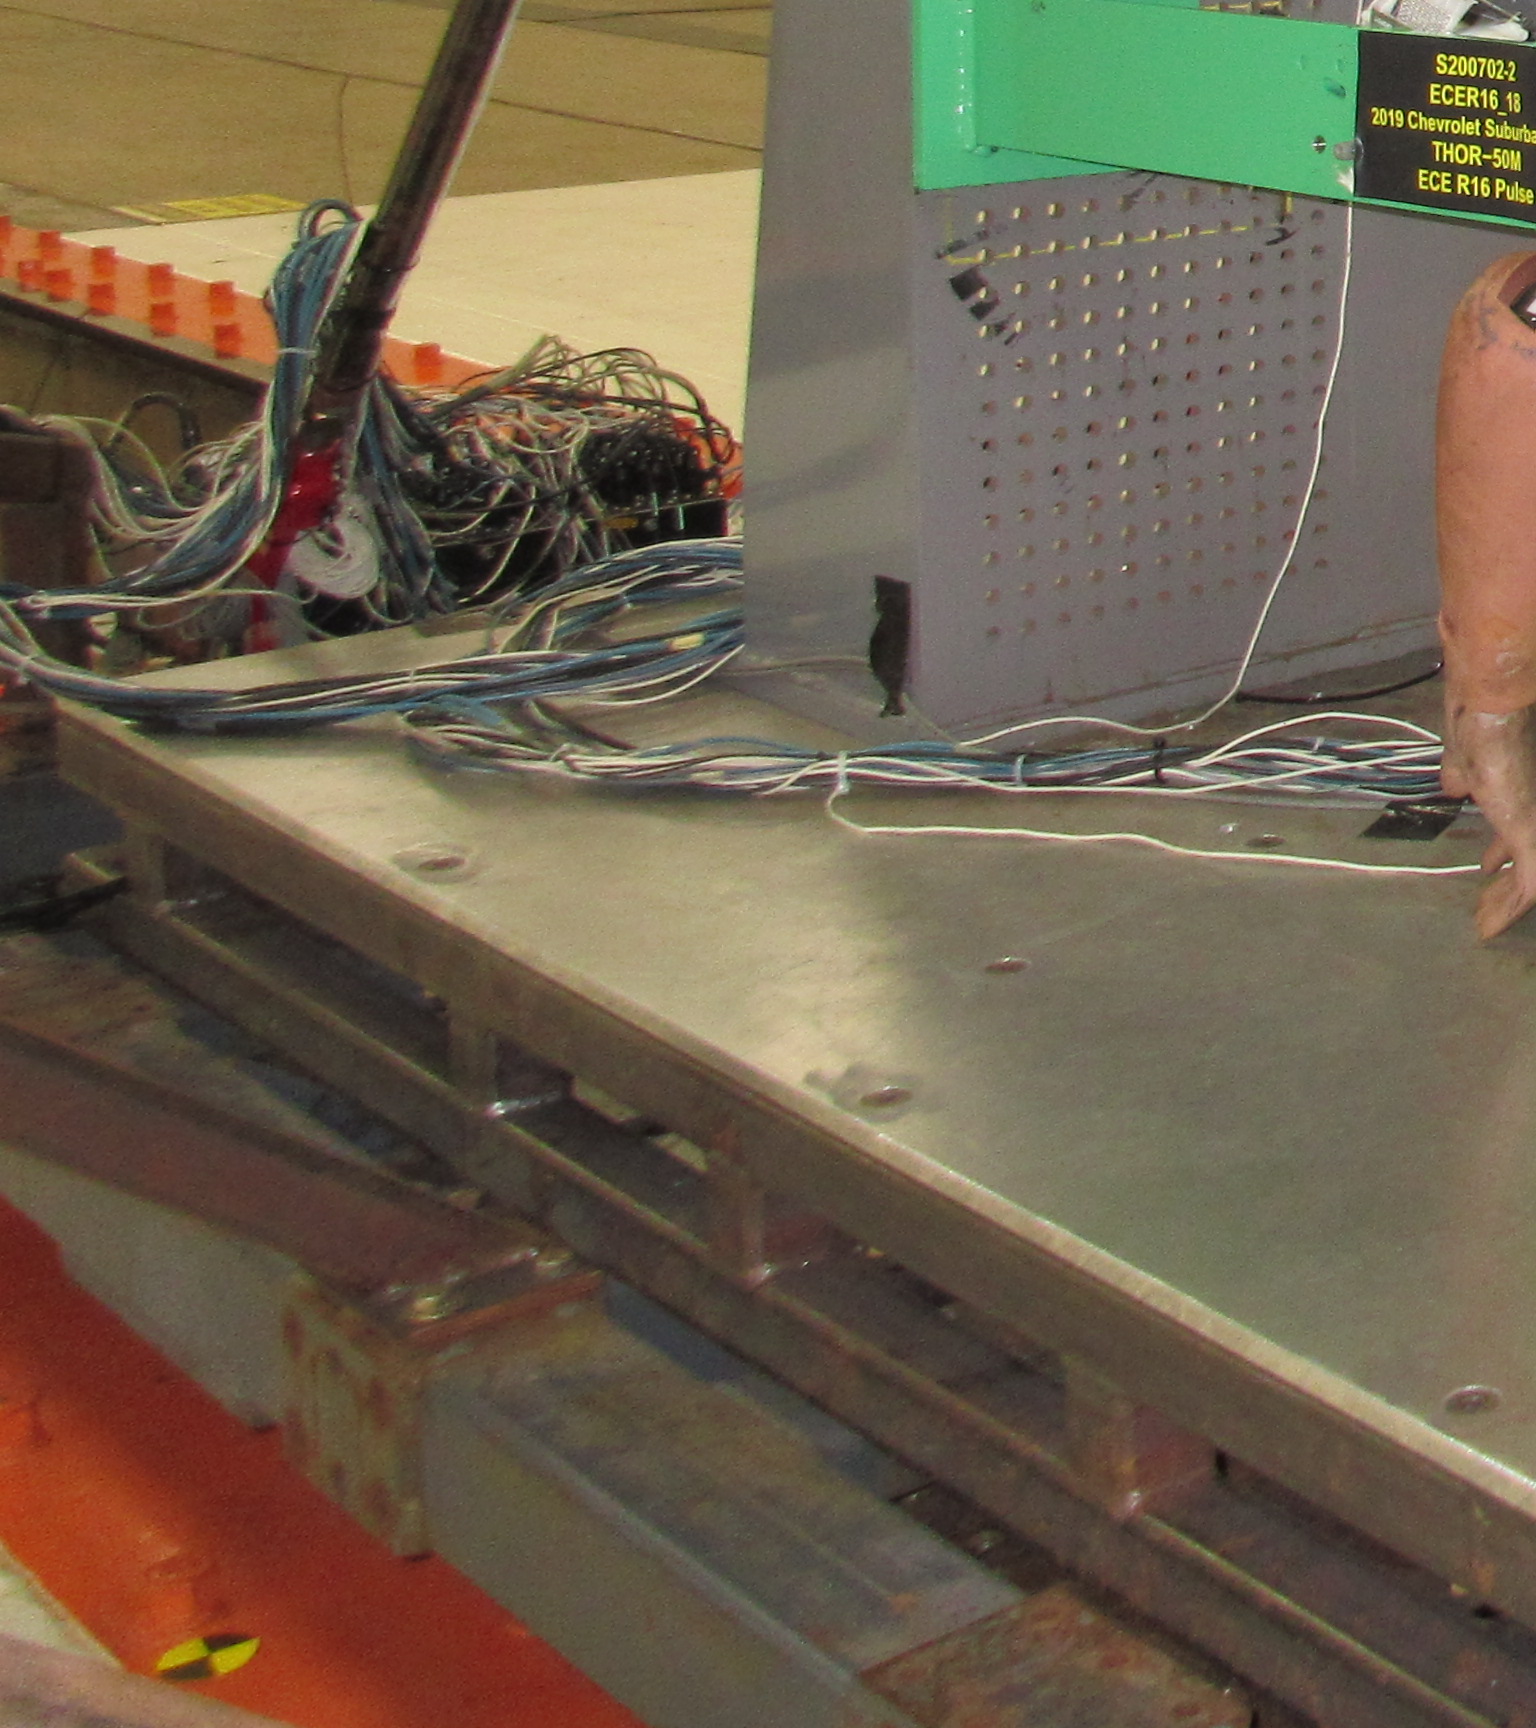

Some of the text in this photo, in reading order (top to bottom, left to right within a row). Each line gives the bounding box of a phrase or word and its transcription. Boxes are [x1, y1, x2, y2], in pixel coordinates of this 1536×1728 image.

[1436, 52, 1517, 82] S200702-2
[1429, 83, 1522, 116] ECER16_18
[1370, 107, 1404, 126] 2019
[1407, 111, 1481, 137] Chevrolet
[1432, 141, 1522, 171] THOR-50M
[1418, 169, 1535, 205] ECE R16 Pulse
